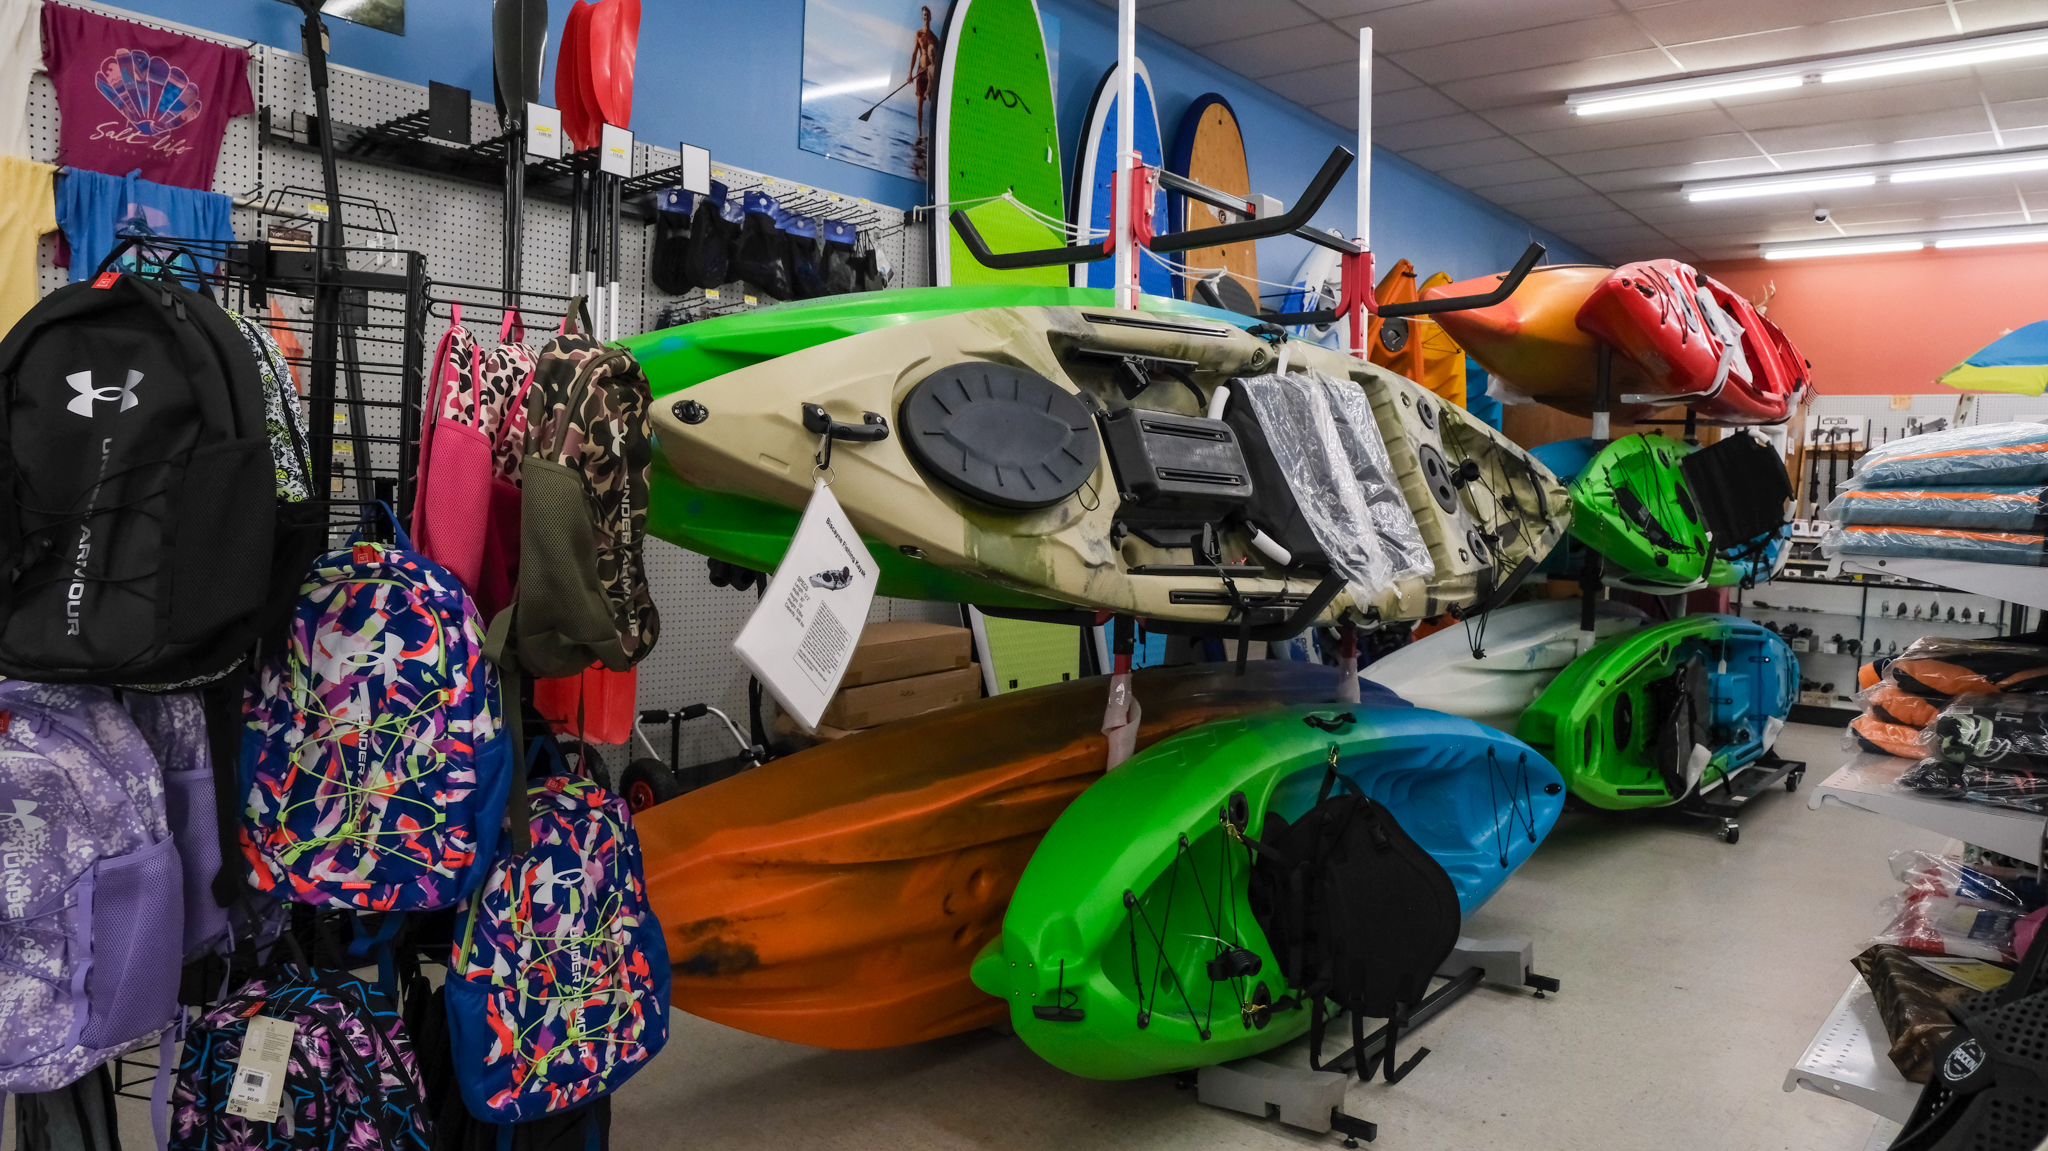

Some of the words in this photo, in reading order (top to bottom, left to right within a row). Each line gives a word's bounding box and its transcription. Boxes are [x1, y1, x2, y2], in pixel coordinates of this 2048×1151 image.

[89, 121, 150, 144] Salt
[621, 476, 632, 545] UNDER
[825, 517, 843, 544] Biscayne
[841, 541, 856, 563] Fishing
[854, 559, 866, 578] Kayak
[67, 523, 92, 636] ARMOUR
[358, 713, 369, 778] UNDER
[570, 926, 582, 983] UNDER
